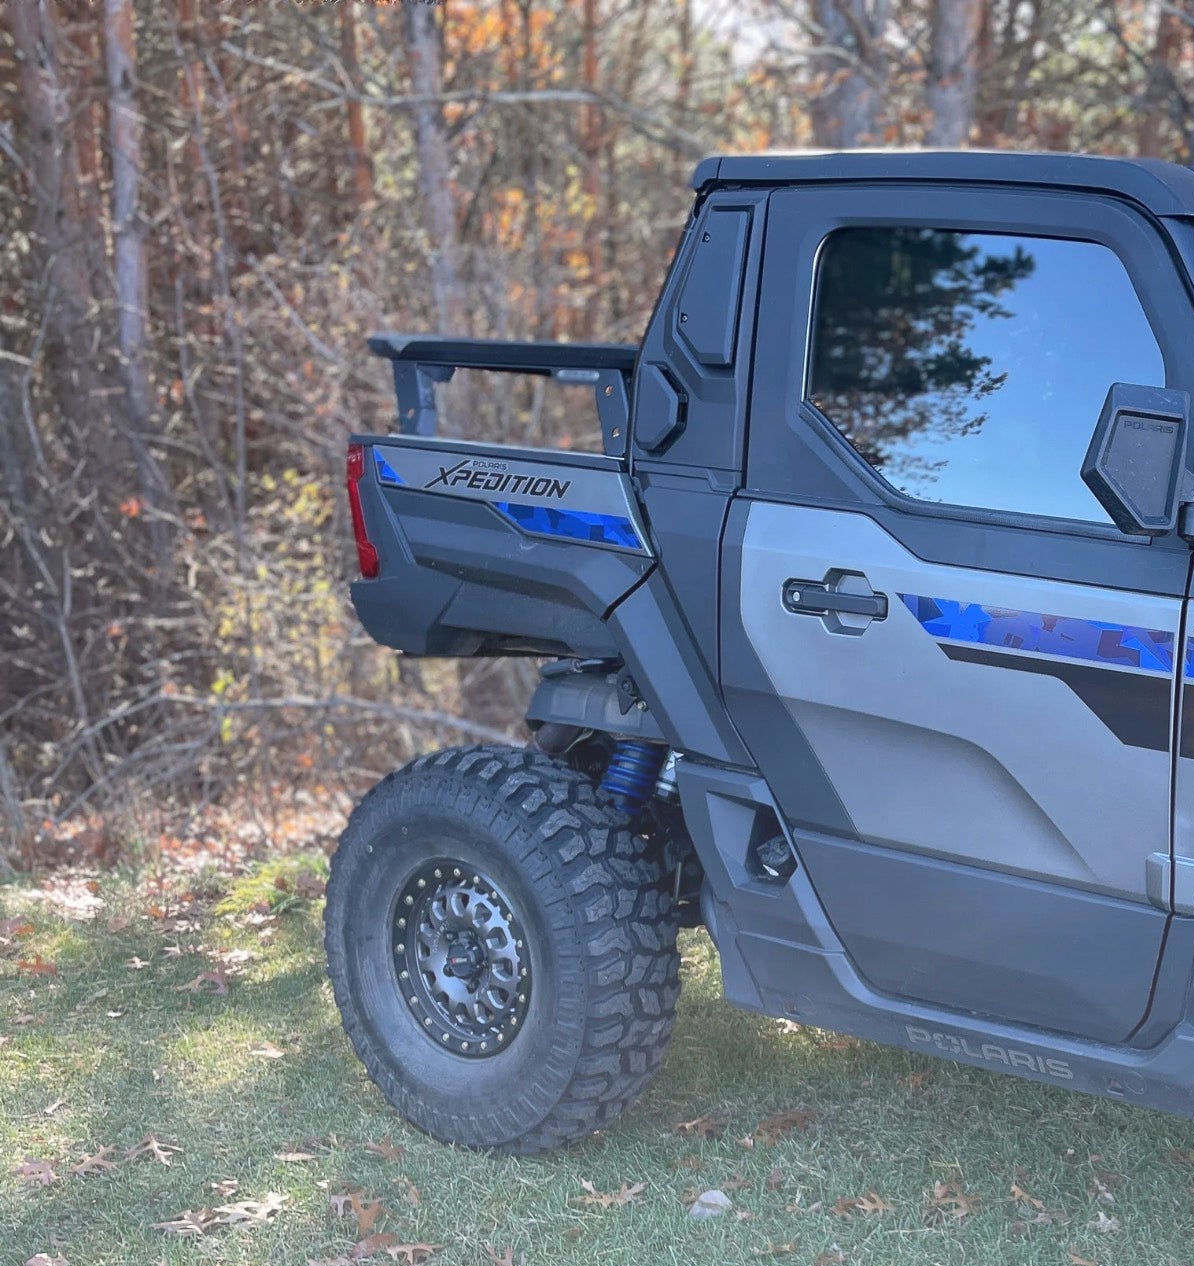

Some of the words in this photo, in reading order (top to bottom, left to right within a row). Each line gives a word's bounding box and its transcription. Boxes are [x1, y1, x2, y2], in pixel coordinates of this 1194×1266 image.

[1123, 420, 1174, 434] POLARIS
[472, 460, 507, 471] POLARIS
[424, 460, 571, 499] XPEDITION
[905, 1024, 1074, 1080] POLARIS
